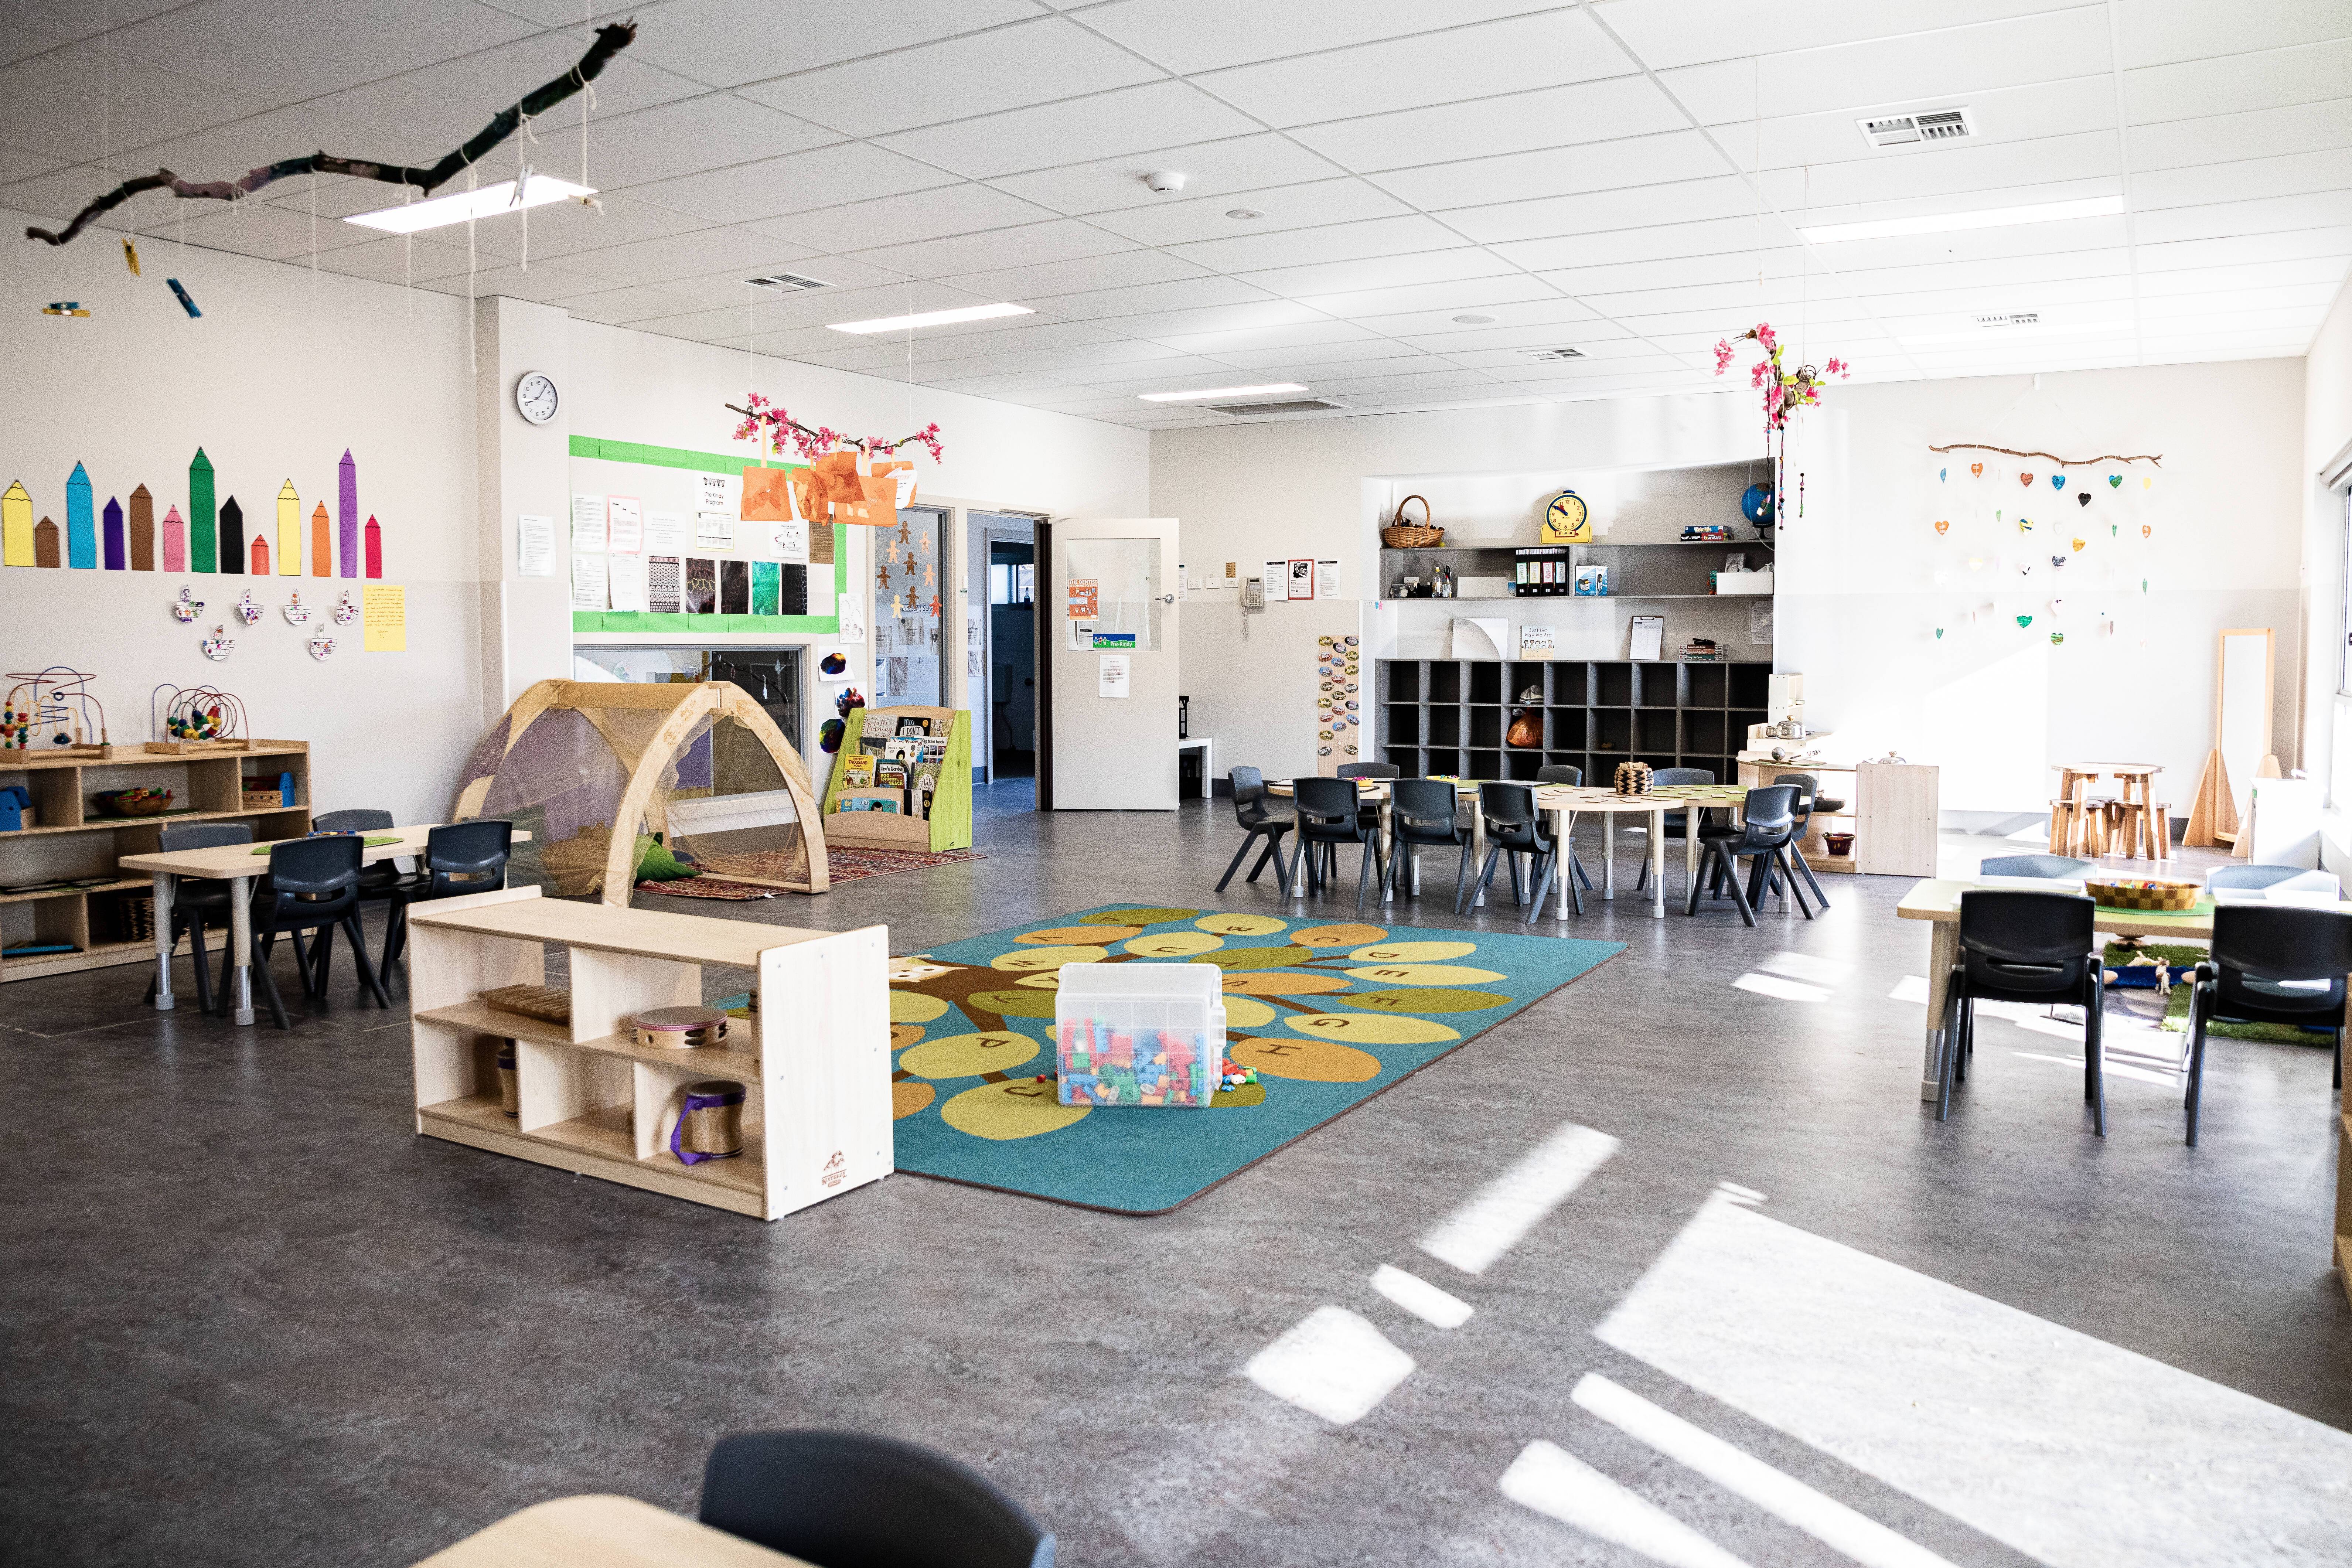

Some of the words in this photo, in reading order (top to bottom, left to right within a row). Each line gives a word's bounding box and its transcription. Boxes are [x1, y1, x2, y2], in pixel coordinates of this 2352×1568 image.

[1370, 997, 1402, 1006] F
[1308, 1018, 1350, 1028] G
[976, 1037, 1011, 1048] P
[1256, 1043, 1302, 1056] H
[1003, 1086, 1044, 1097] J
